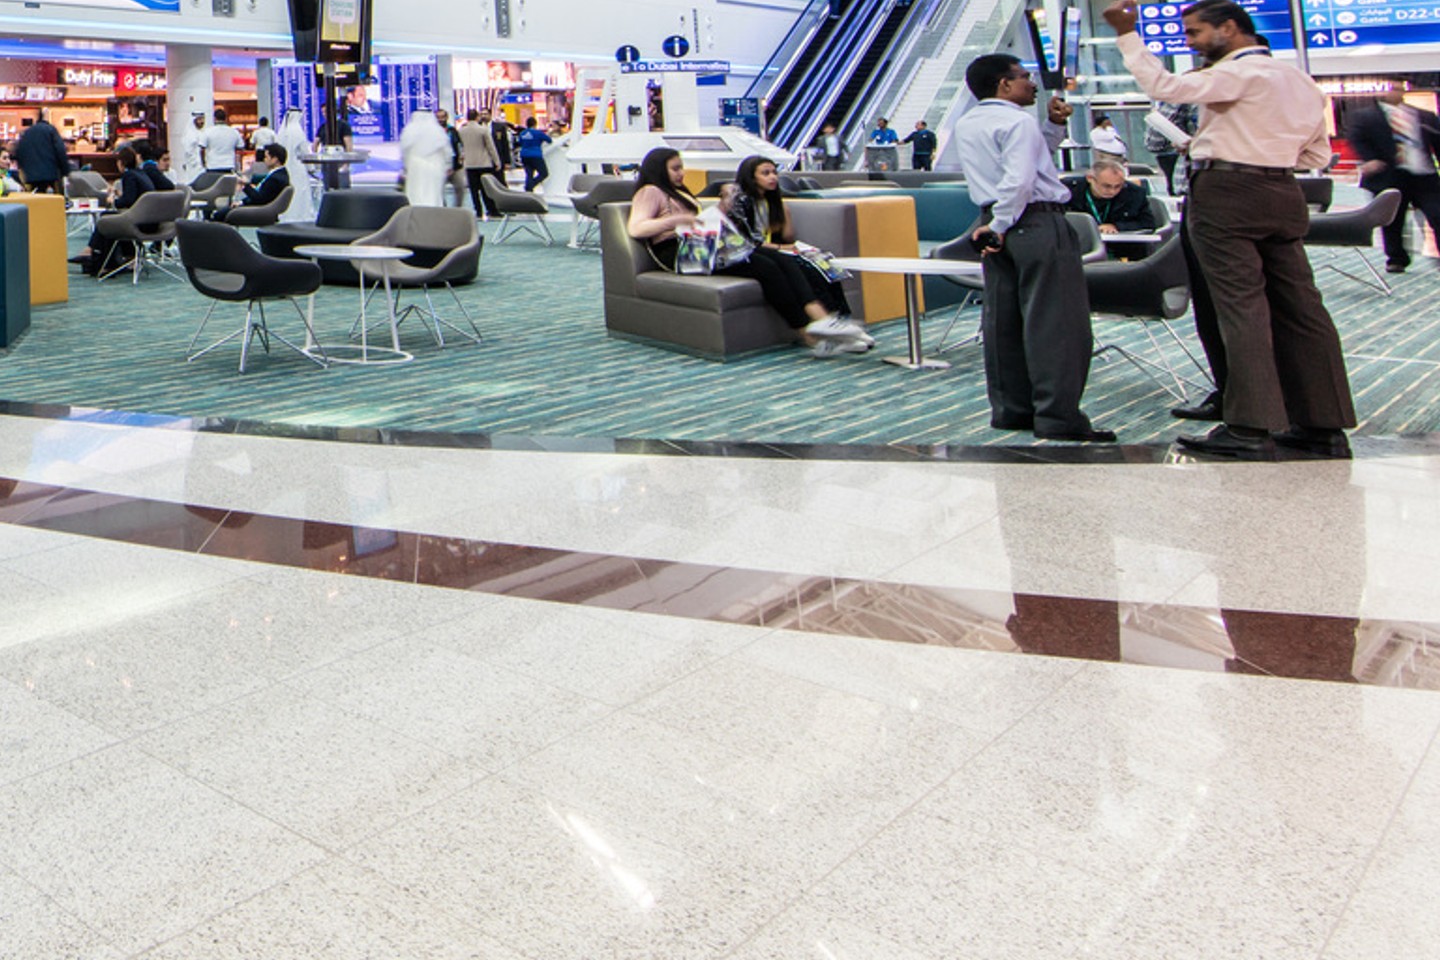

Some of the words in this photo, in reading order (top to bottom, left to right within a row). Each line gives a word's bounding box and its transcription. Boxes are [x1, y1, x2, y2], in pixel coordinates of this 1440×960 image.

[1360, 16, 1390, 24] Gates
[632, 62, 646, 71] To
[648, 61, 678, 71] Dubai
[64, 69, 92, 86] Duty
[93, 70, 116, 85] Free
